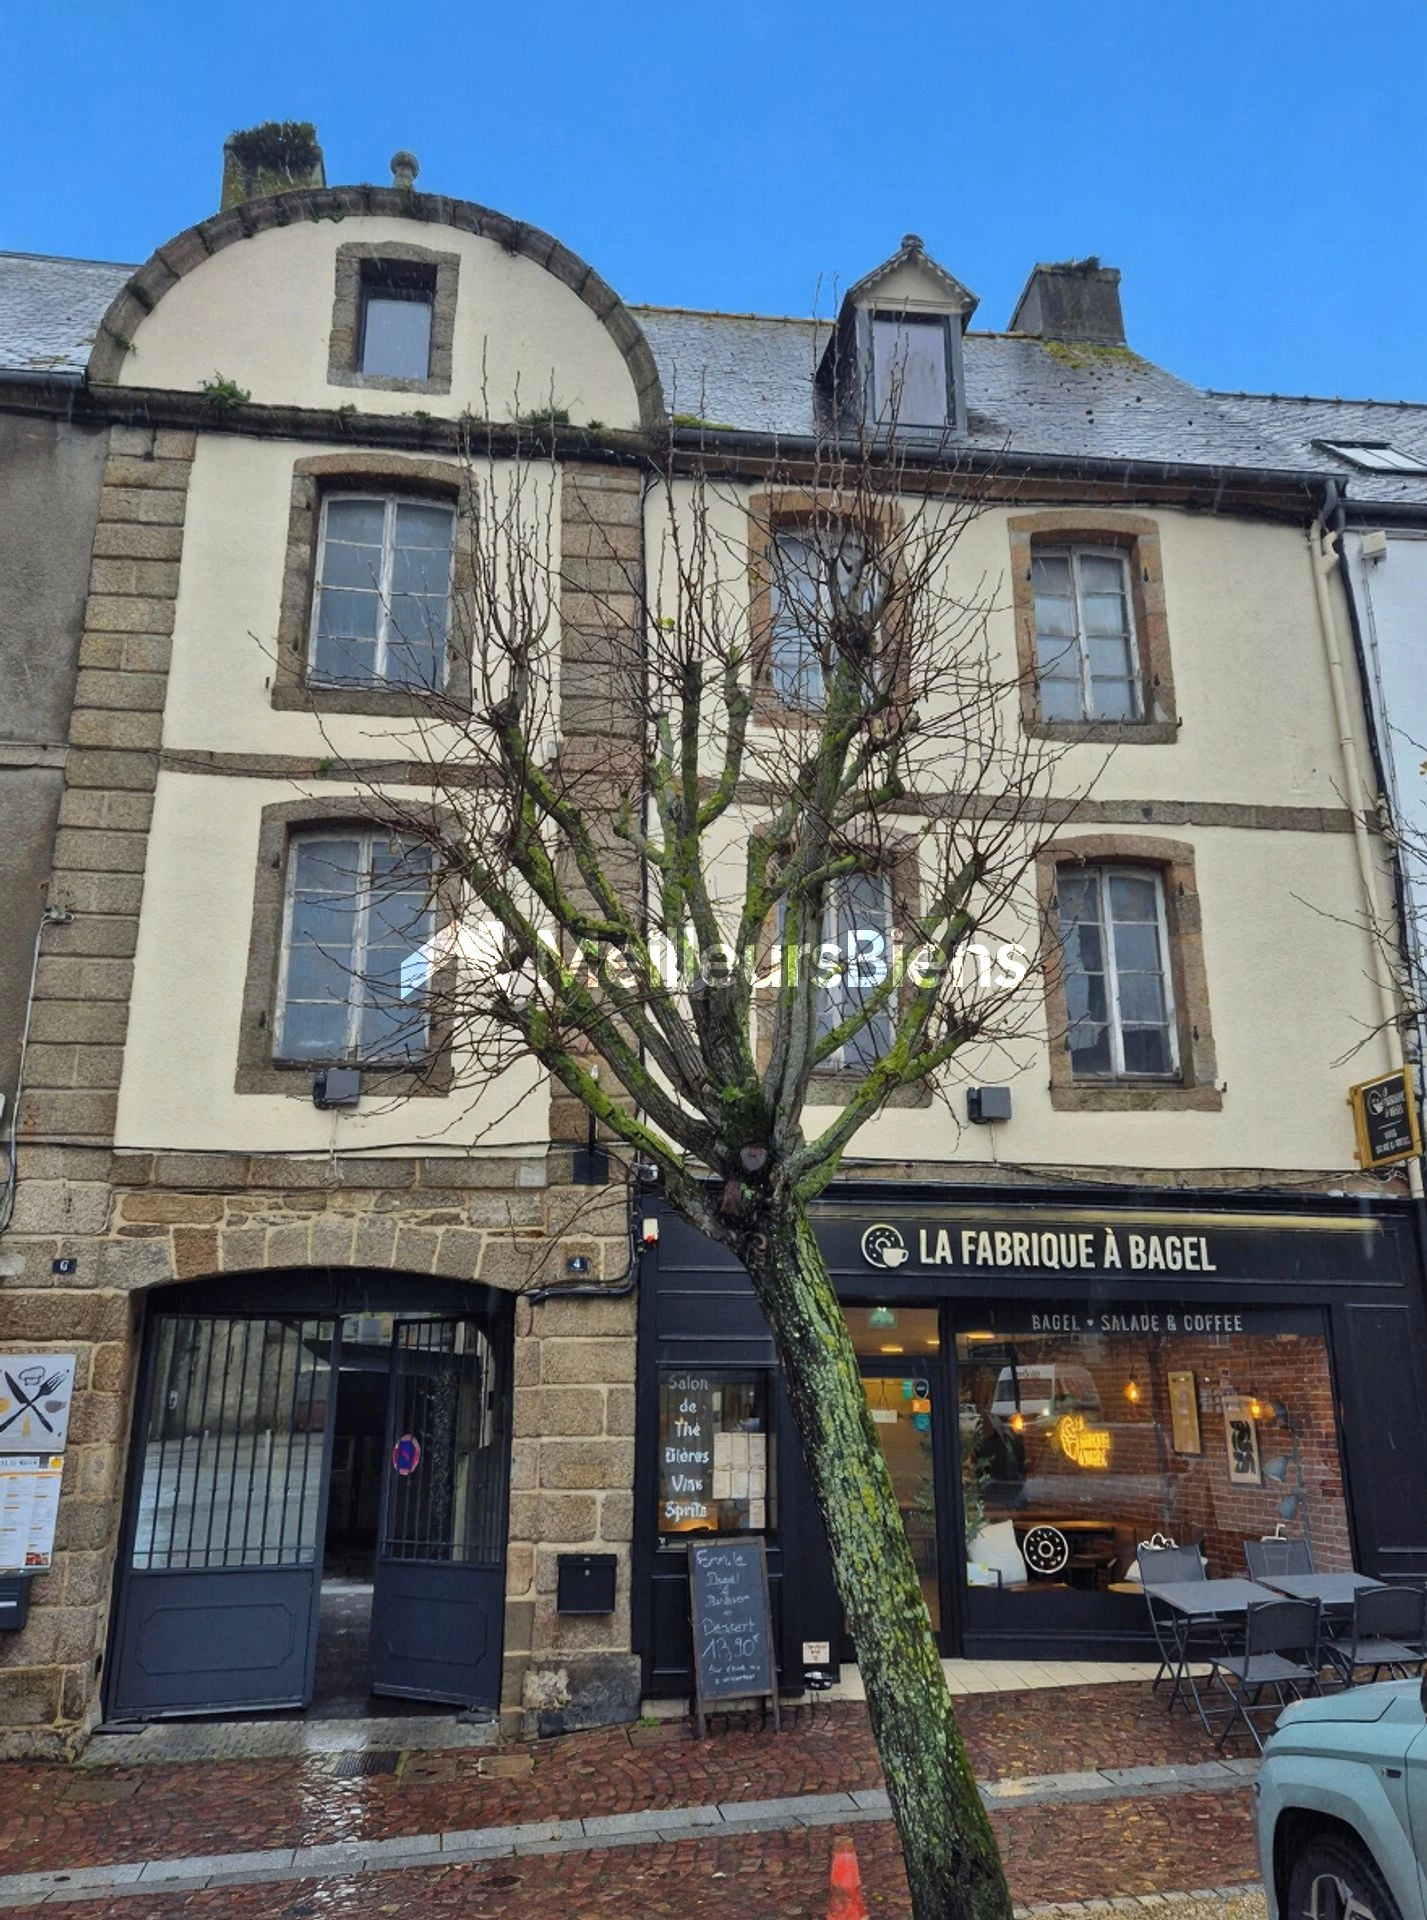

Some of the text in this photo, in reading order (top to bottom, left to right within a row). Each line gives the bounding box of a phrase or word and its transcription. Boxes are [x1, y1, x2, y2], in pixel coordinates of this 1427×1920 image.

[919, 1227, 1217, 1271] LA FABRIQUE À BAGEL
[60, 1260, 70, 1271] 6
[1032, 1314, 1243, 1331] BAGEL SALADE & COFFEE
[668, 1375, 709, 1391] Salon
[679, 1398, 697, 1413] de
[665, 1447, 710, 1463] Bières
[671, 1474, 703, 1492] Vins
